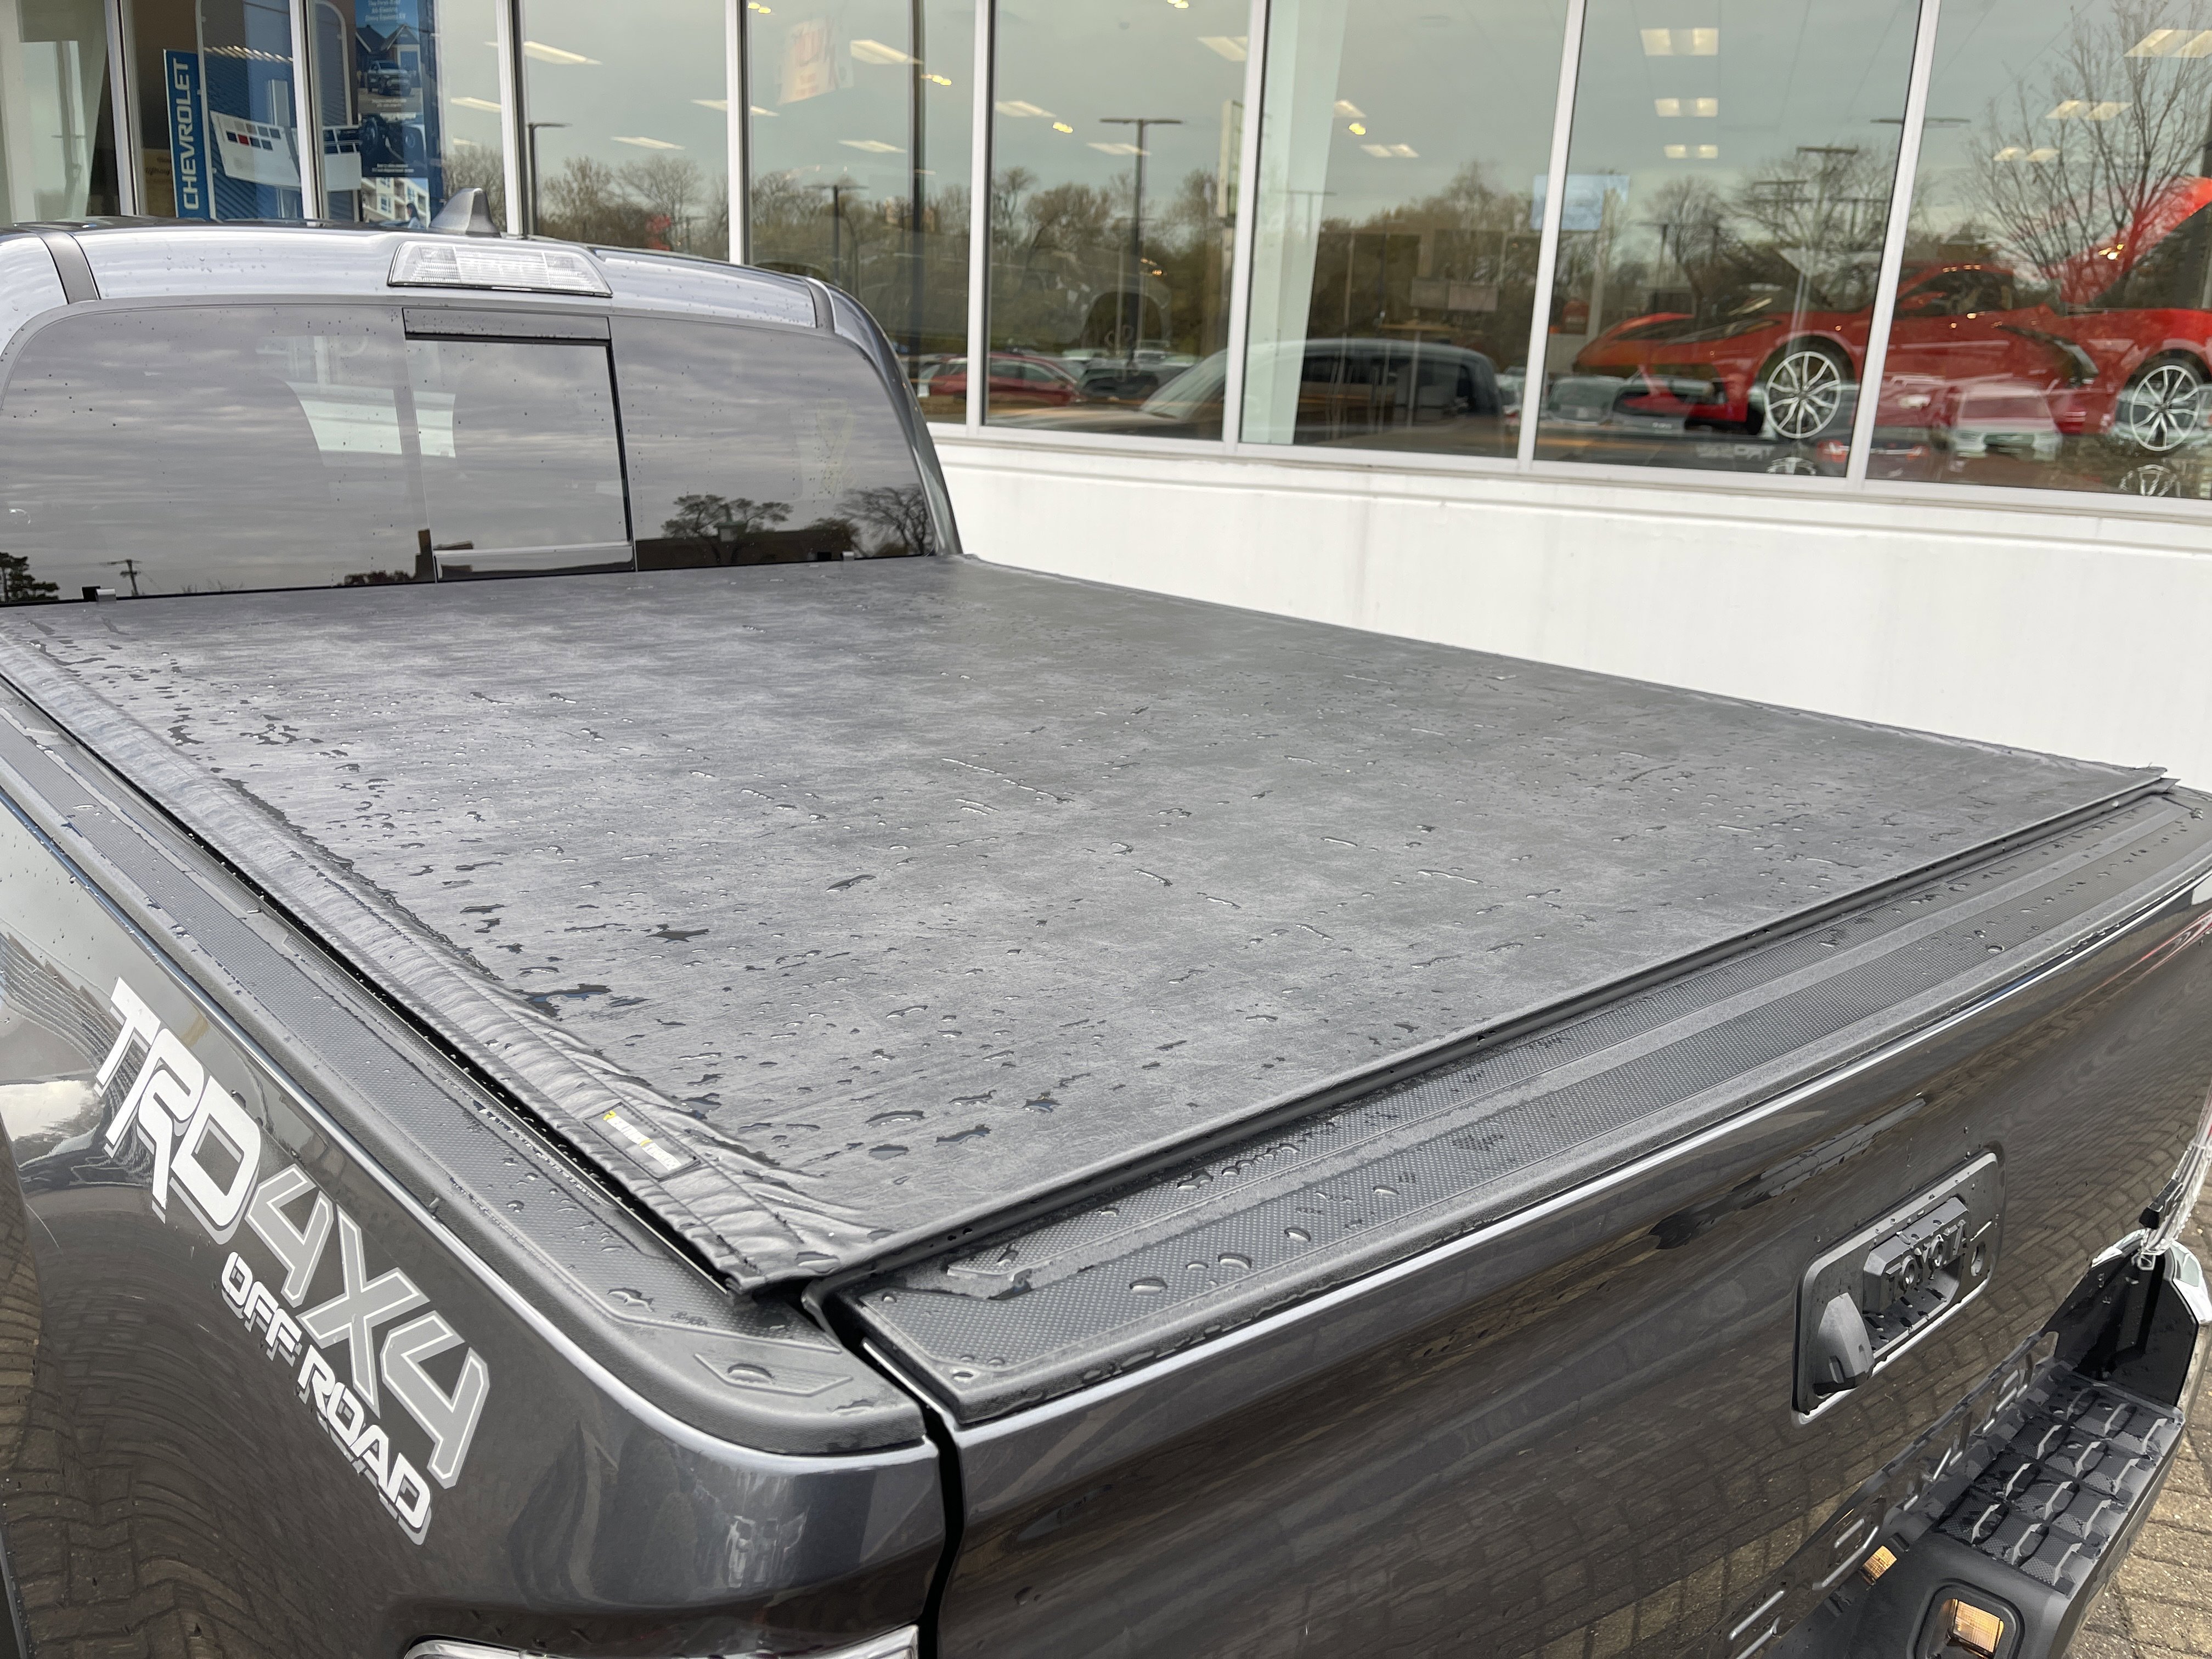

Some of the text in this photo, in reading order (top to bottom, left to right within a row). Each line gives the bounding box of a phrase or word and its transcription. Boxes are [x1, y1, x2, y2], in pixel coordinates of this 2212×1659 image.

[173, 57, 199, 210] CHEVROLET
[94, 977, 490, 1489] TRD 4X4
[222, 1251, 432, 1545] OFF ROAD
